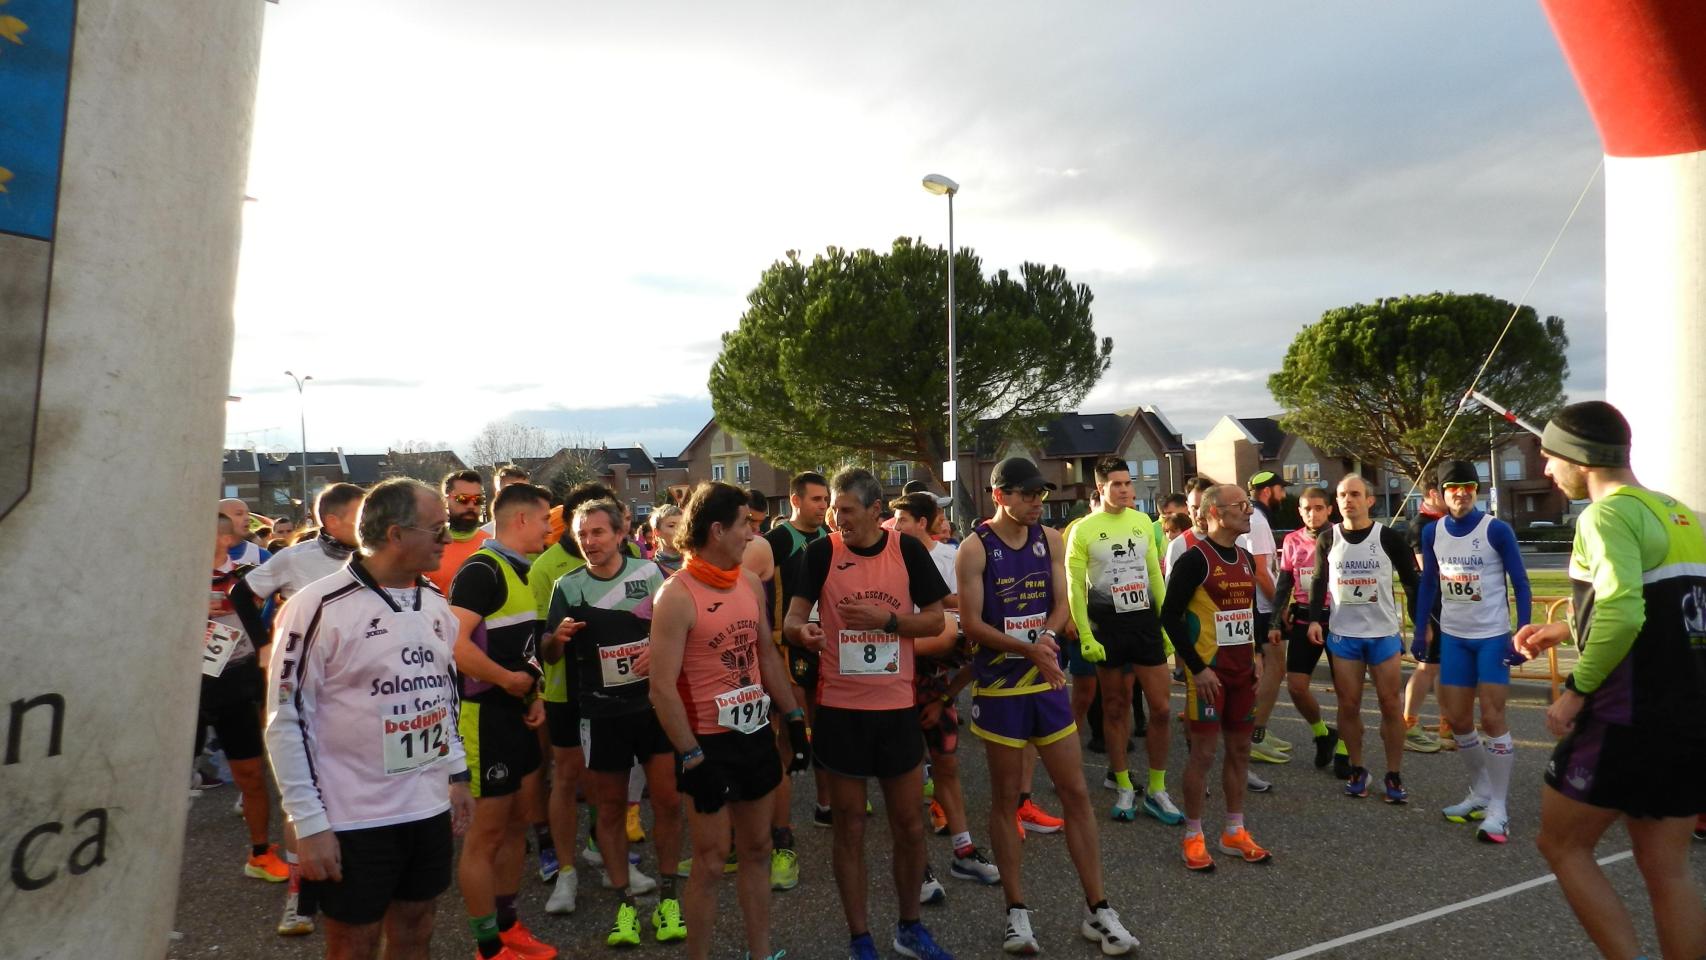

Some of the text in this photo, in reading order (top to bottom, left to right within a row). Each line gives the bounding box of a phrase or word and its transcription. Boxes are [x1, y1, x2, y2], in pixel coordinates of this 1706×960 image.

[1345, 558, 1381, 570] ARMUÑA
[1447, 555, 1484, 566] ARMUÑA
[1120, 590, 1145, 606] 100
[1353, 585, 1363, 598] 4
[1446, 582, 1474, 596] 186
[864, 590, 902, 610] ESCAPADA
[840, 631, 899, 644] bedunia
[1027, 629, 1037, 645] 9
[1224, 620, 1251, 638] 148
[202, 632, 230, 663] 161
[401, 645, 434, 668] Caja
[863, 643, 877, 664] 8
[384, 706, 448, 736] bedunia
[730, 700, 763, 726] 191
[400, 723, 443, 759] 112
[10, 807, 110, 892] ca
